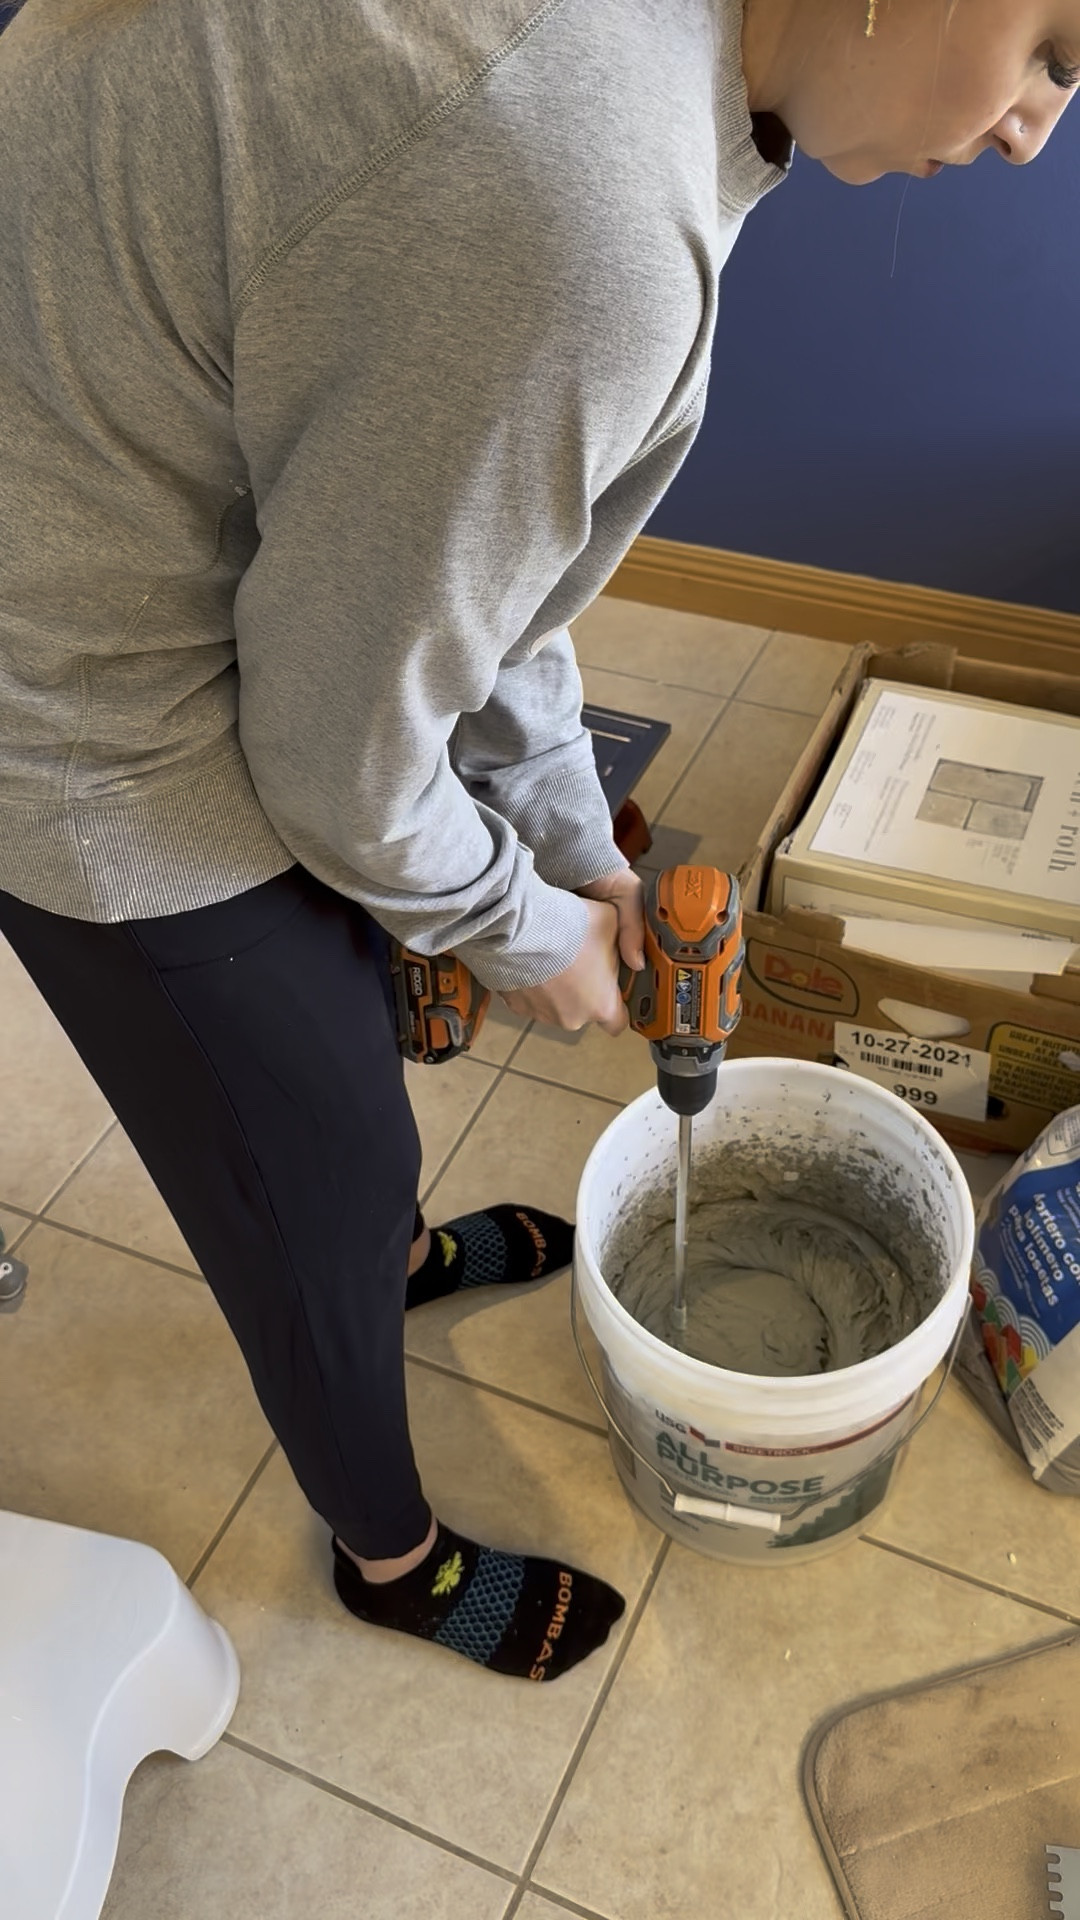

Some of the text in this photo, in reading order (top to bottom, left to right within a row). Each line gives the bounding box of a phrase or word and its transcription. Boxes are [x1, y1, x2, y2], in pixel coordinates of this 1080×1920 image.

[1048, 824, 1079, 871] roth
[409, 966, 424, 996] RIDGID
[764, 953, 844, 997] Dole
[851, 1031, 972, 1067] 10-27-2021
[892, 1083, 938, 1106] 999
[515, 1212, 547, 1277] BOMBAS
[1024, 1242, 1059, 1306] losetas
[655, 1430, 719, 1471] ALL
[656, 1441, 825, 1495] PURPOSE
[529, 1571, 573, 1682] BOMBAS
